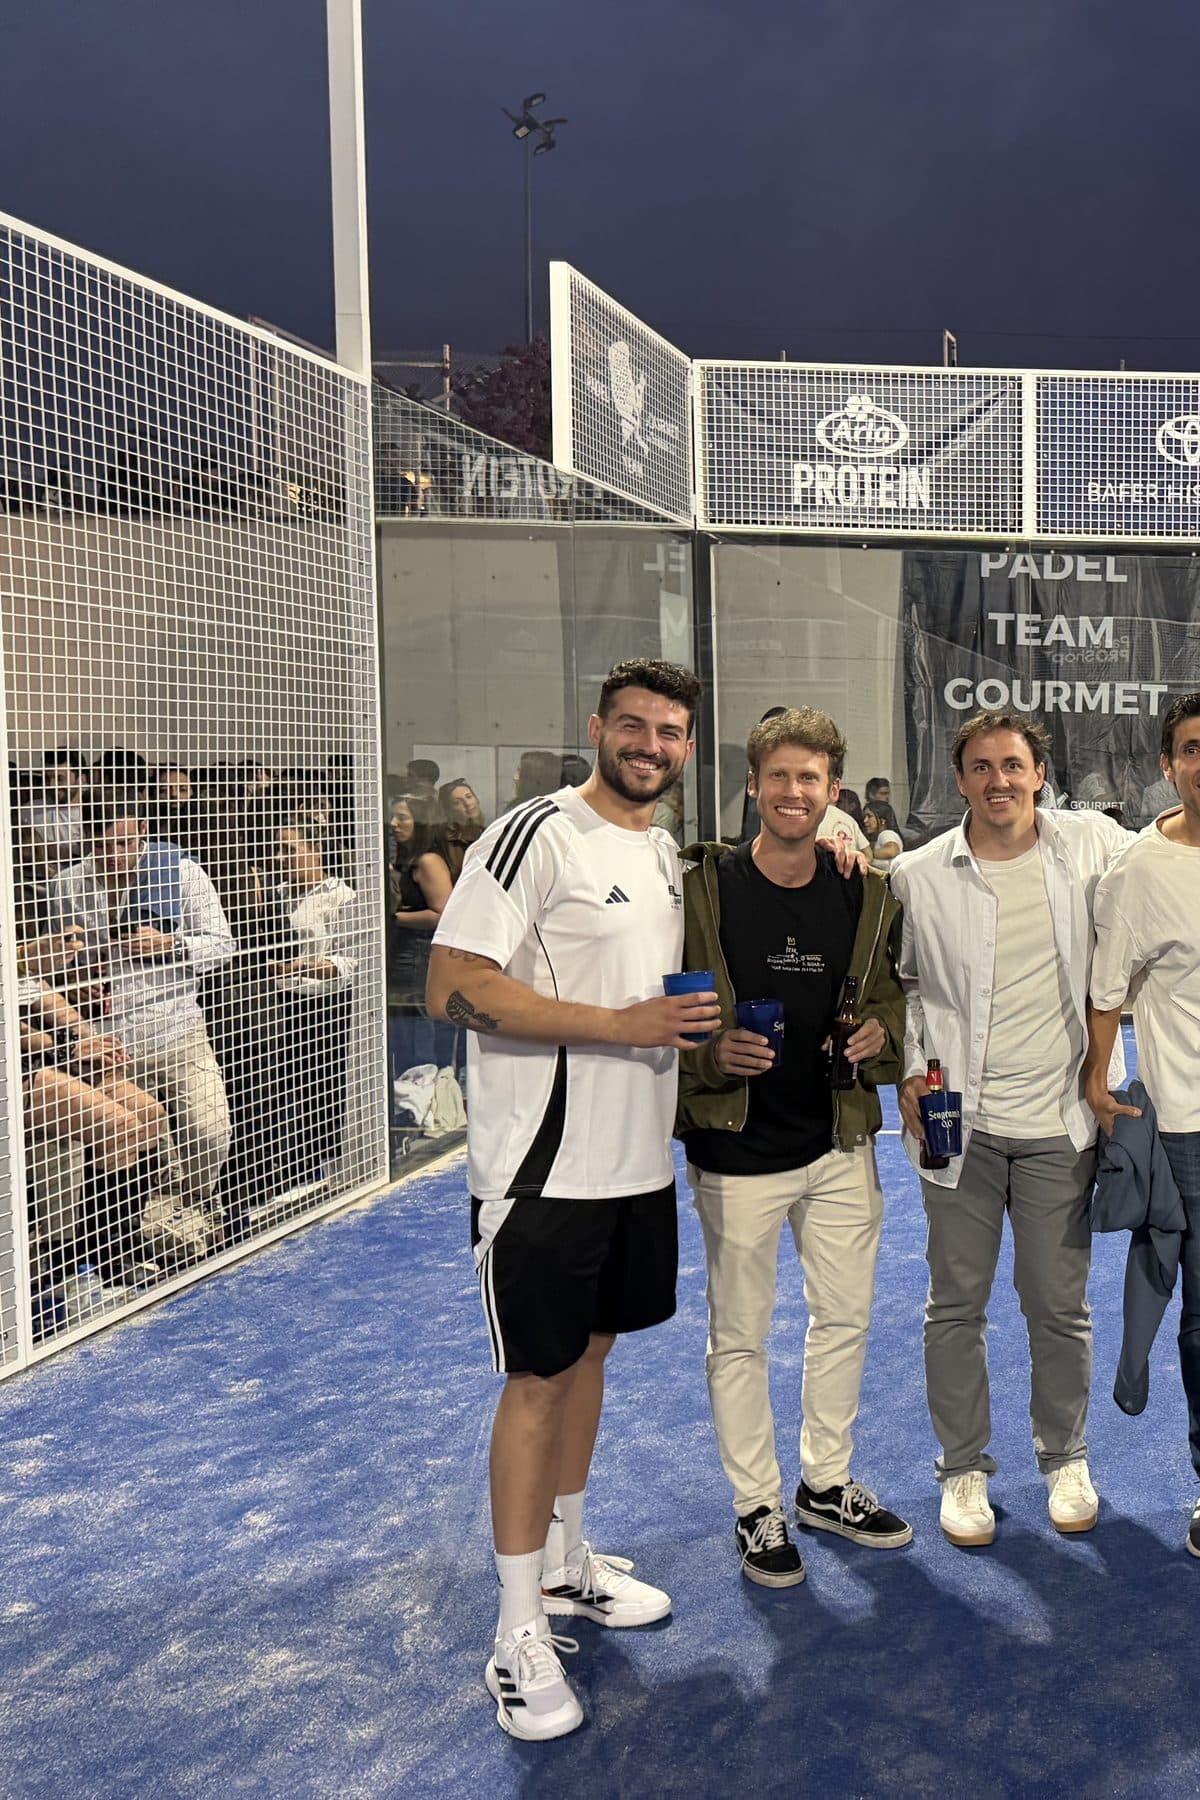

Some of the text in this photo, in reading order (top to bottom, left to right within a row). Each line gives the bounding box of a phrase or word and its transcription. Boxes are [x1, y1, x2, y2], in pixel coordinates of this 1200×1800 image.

[832, 418, 892, 444] Arla
[793, 463, 931, 509] PROTEIN
[1087, 480, 1159, 504] BAFER
[980, 552, 1129, 583] PADEL
[987, 612, 1114, 649] TEAM
[943, 677, 1169, 716] GOURMET
[1070, 800, 1126, 811] GOURMET
